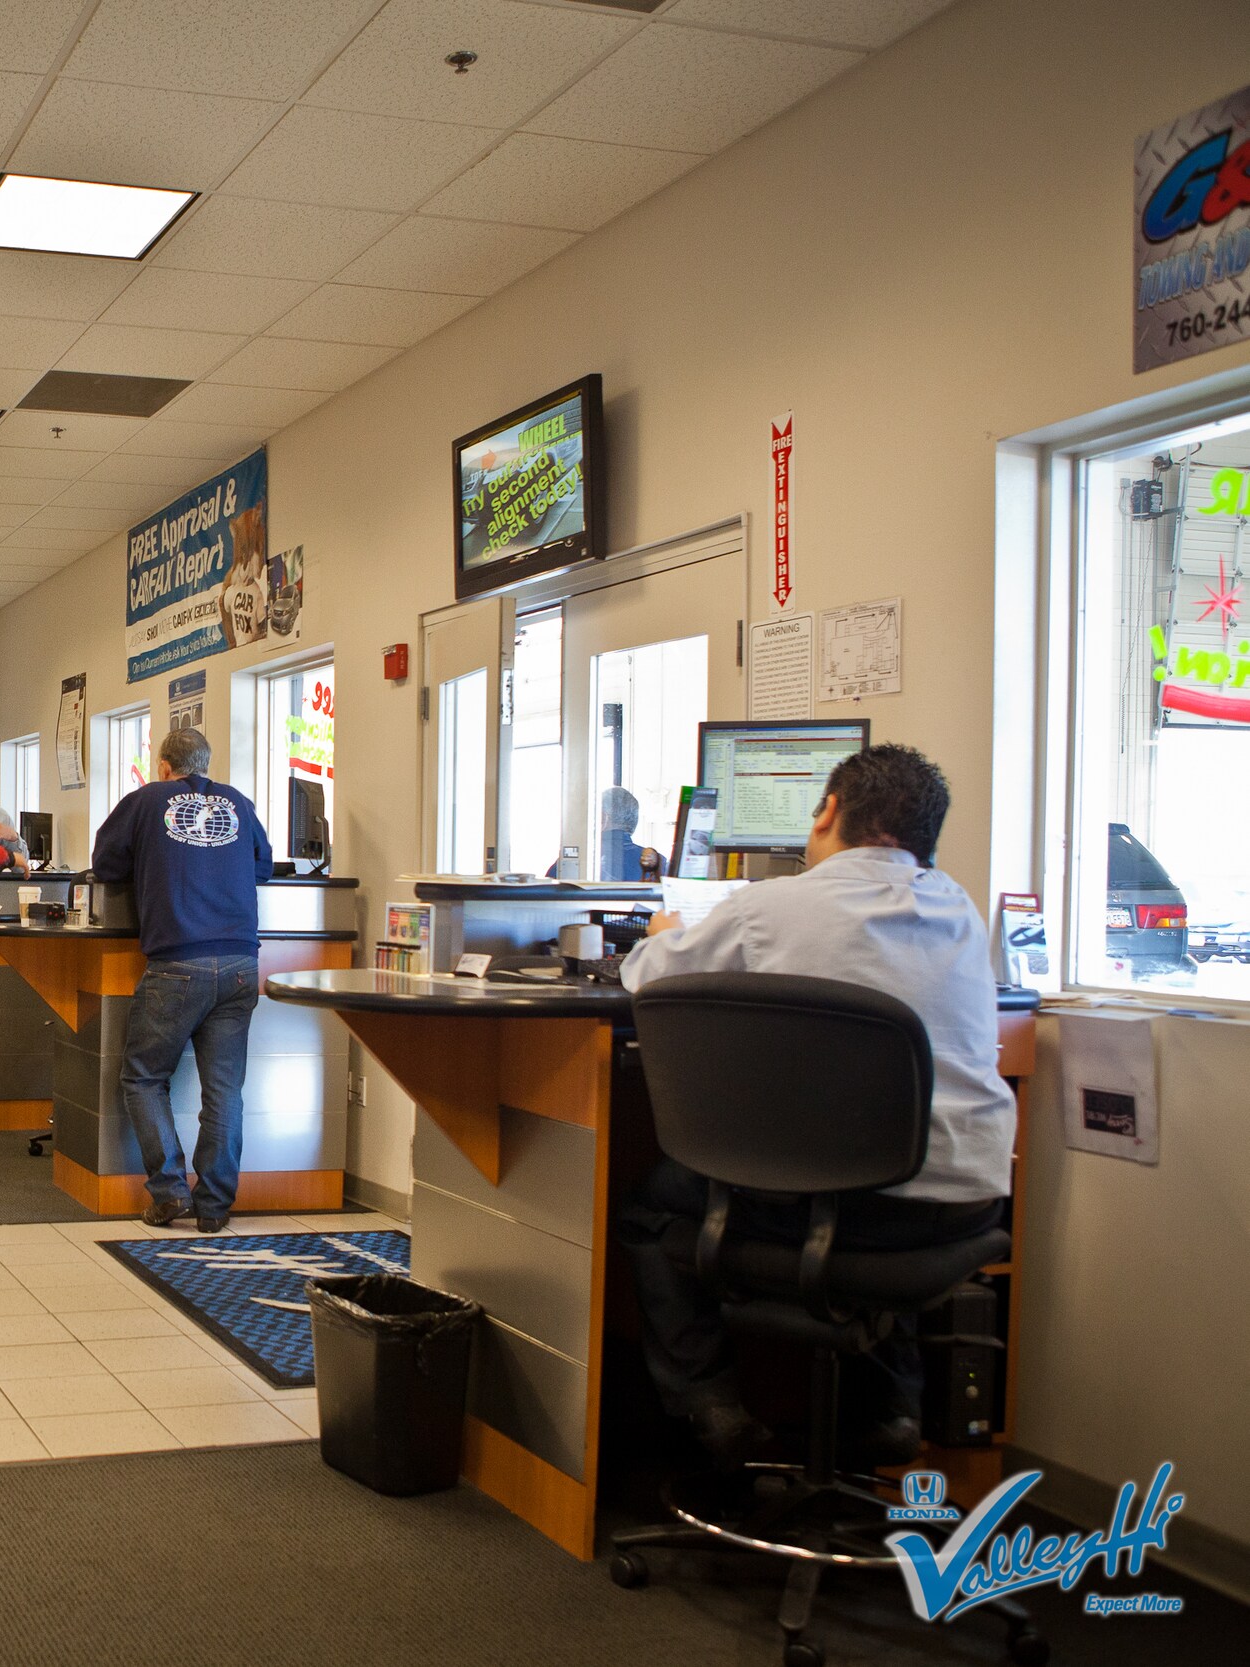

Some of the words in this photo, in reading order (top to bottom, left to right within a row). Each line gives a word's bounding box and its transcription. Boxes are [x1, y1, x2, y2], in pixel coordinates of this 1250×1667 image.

[518, 414, 566, 452] WHEEL
[773, 434, 792, 453] FIRE
[488, 458, 567, 536] alignment
[491, 451, 550, 512] second
[462, 490, 485, 516] Try
[482, 514, 529, 560] check
[529, 463, 584, 520] today!
[130, 524, 158, 570] FREE
[223, 479, 237, 518] &
[776, 452, 787, 601] EXTINGUISHER
[175, 534, 224, 588] Report
[234, 592, 253, 613] CAR
[234, 614, 252, 634] FOX
[764, 623, 800, 638] WARNING
[167, 793, 235, 810] KEVINGSTON
